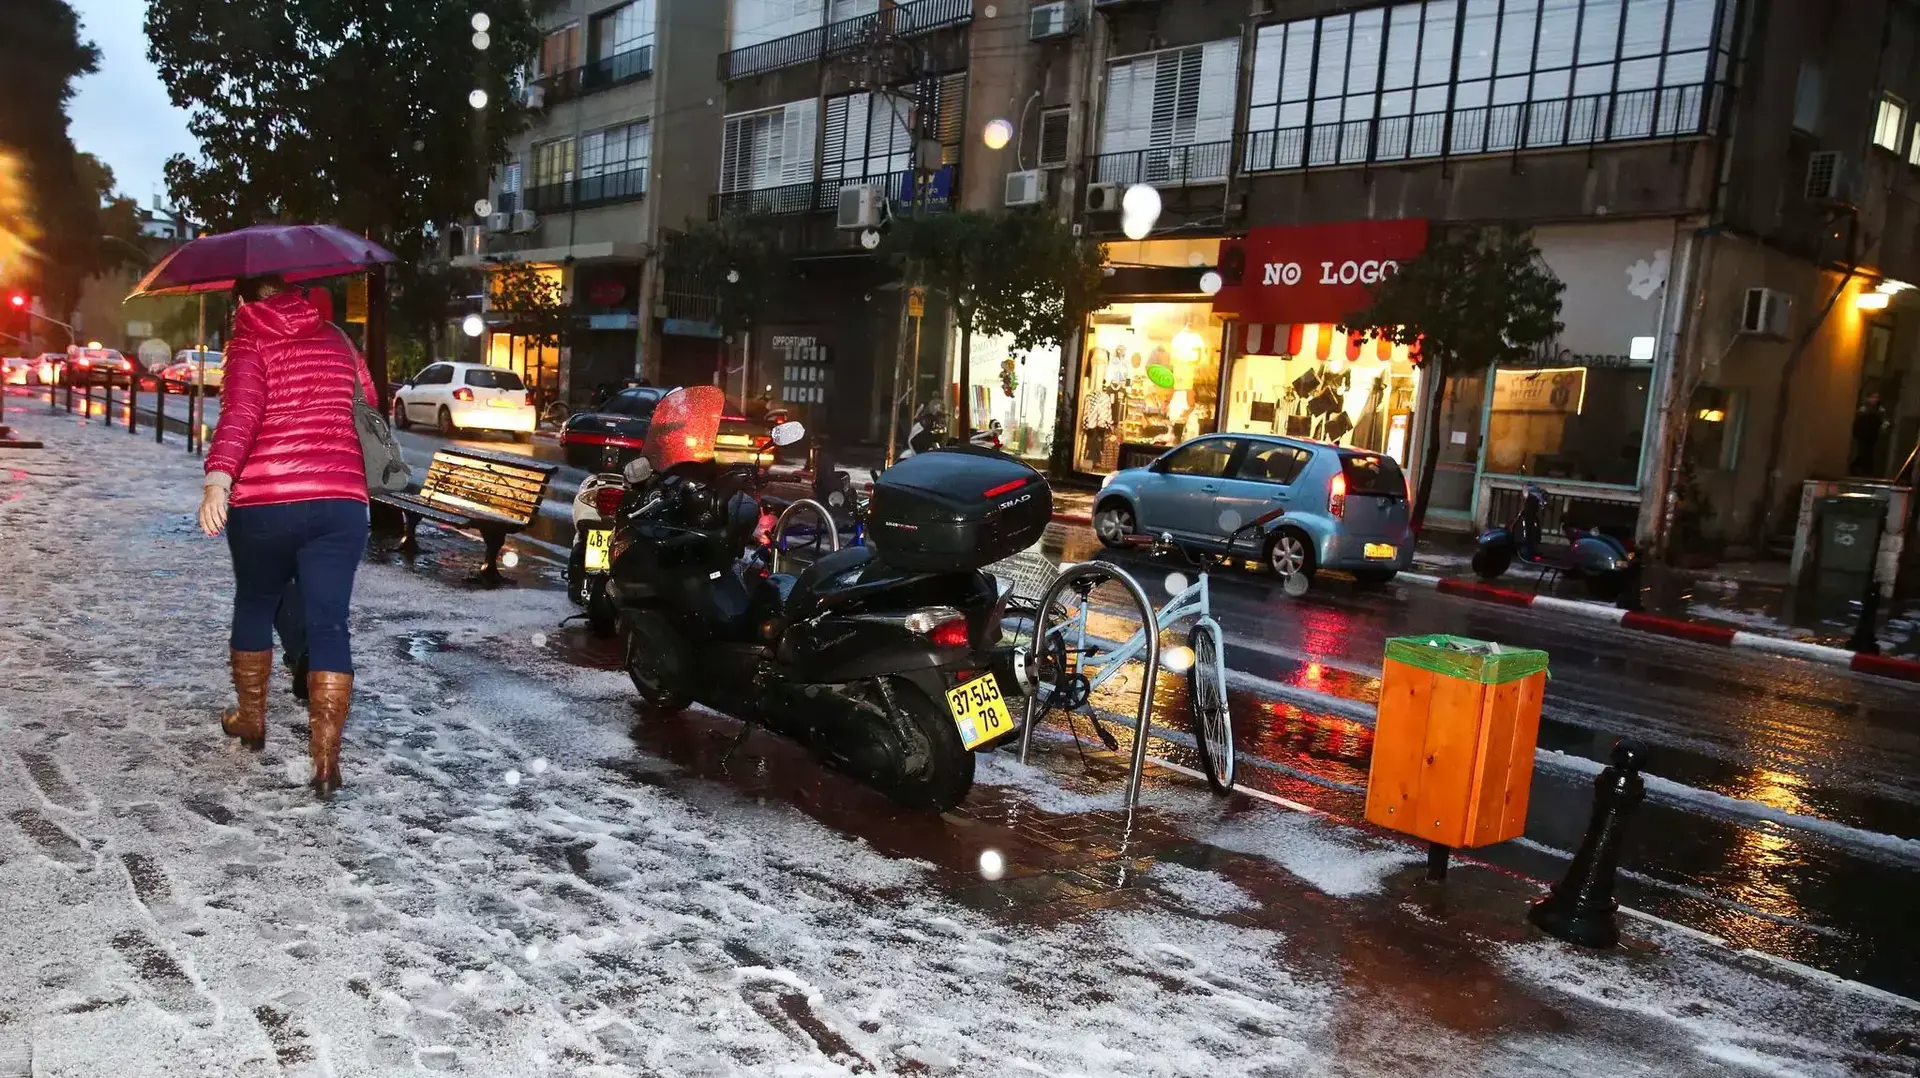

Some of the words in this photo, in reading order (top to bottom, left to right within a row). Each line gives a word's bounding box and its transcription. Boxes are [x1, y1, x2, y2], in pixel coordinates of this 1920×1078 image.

[1262, 262, 1301, 285] NO
[772, 336, 817, 346] OPPORTUNITY
[978, 707, 1000, 732] 78
